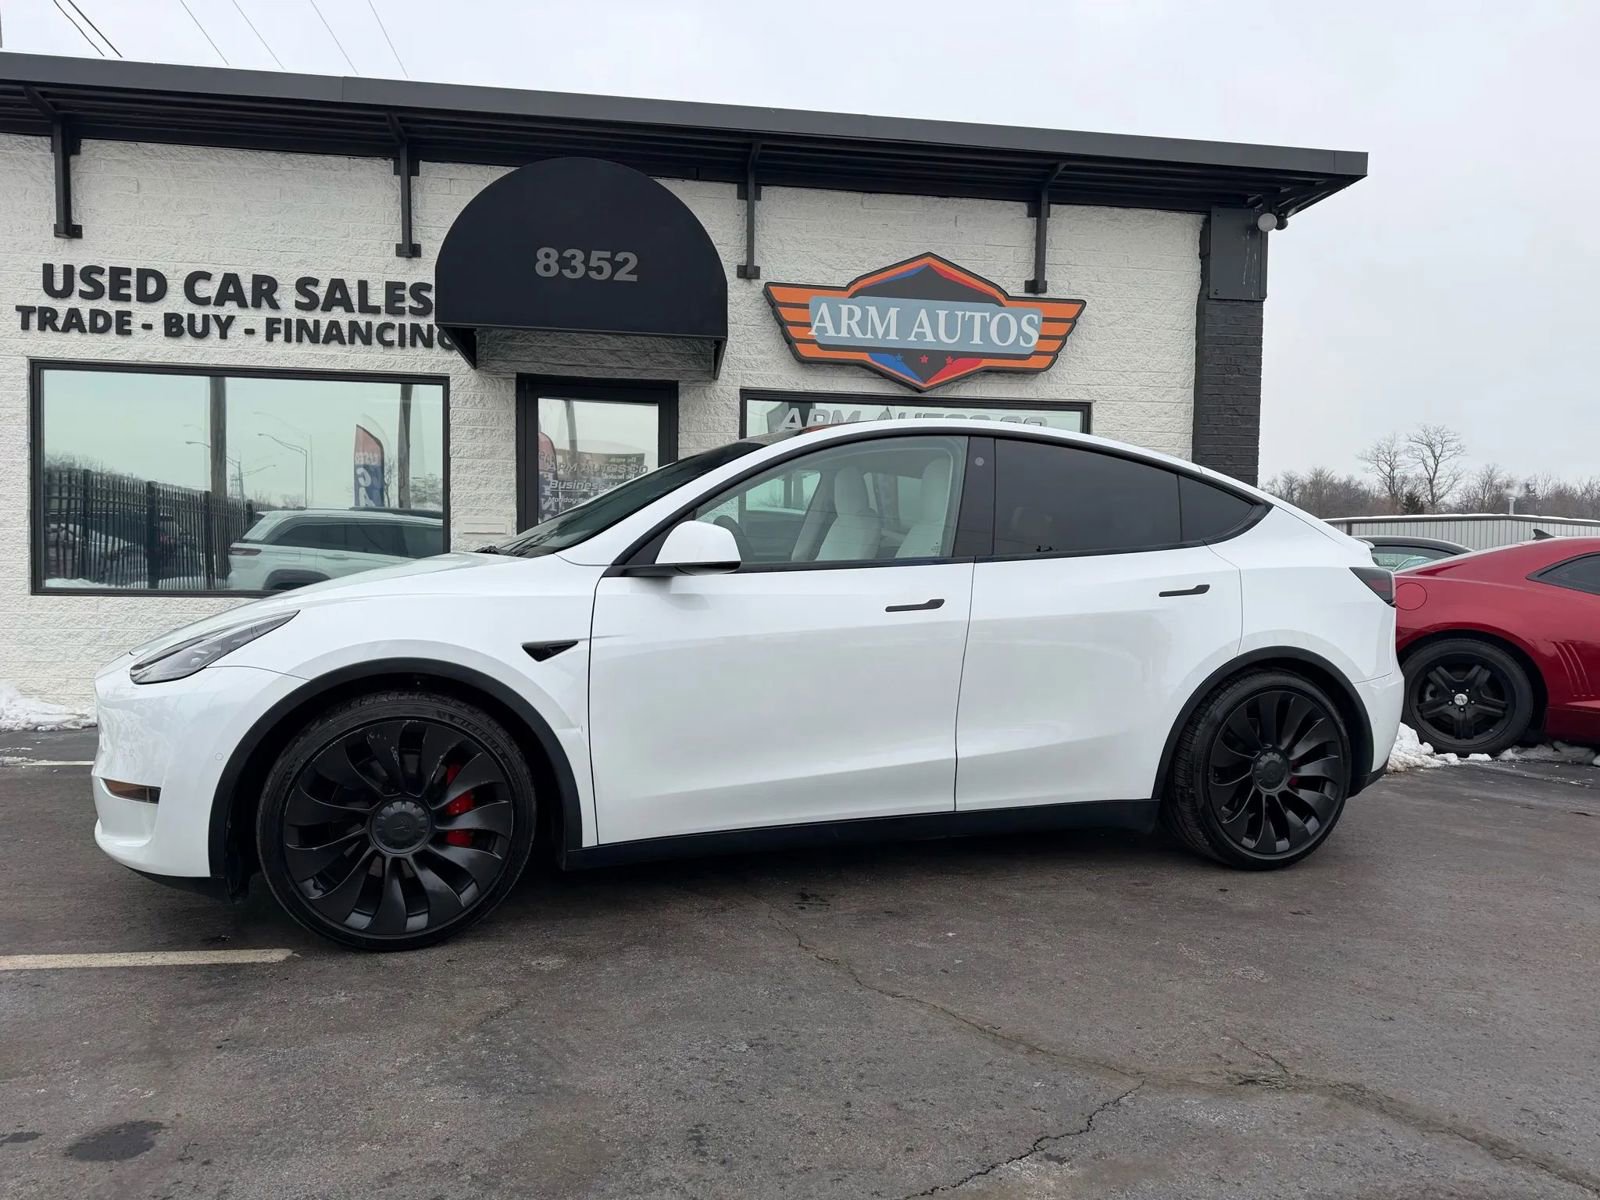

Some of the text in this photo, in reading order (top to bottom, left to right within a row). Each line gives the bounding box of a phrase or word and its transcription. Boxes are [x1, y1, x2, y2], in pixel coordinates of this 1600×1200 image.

[535, 246, 638, 282] 8352
[42, 263, 434, 316] USED CAR SALES
[15, 304, 132, 335] TRADE
[163, 312, 236, 340] BUY
[808, 302, 1040, 348] ARM AUTOS
[549, 479, 608, 492] Business
